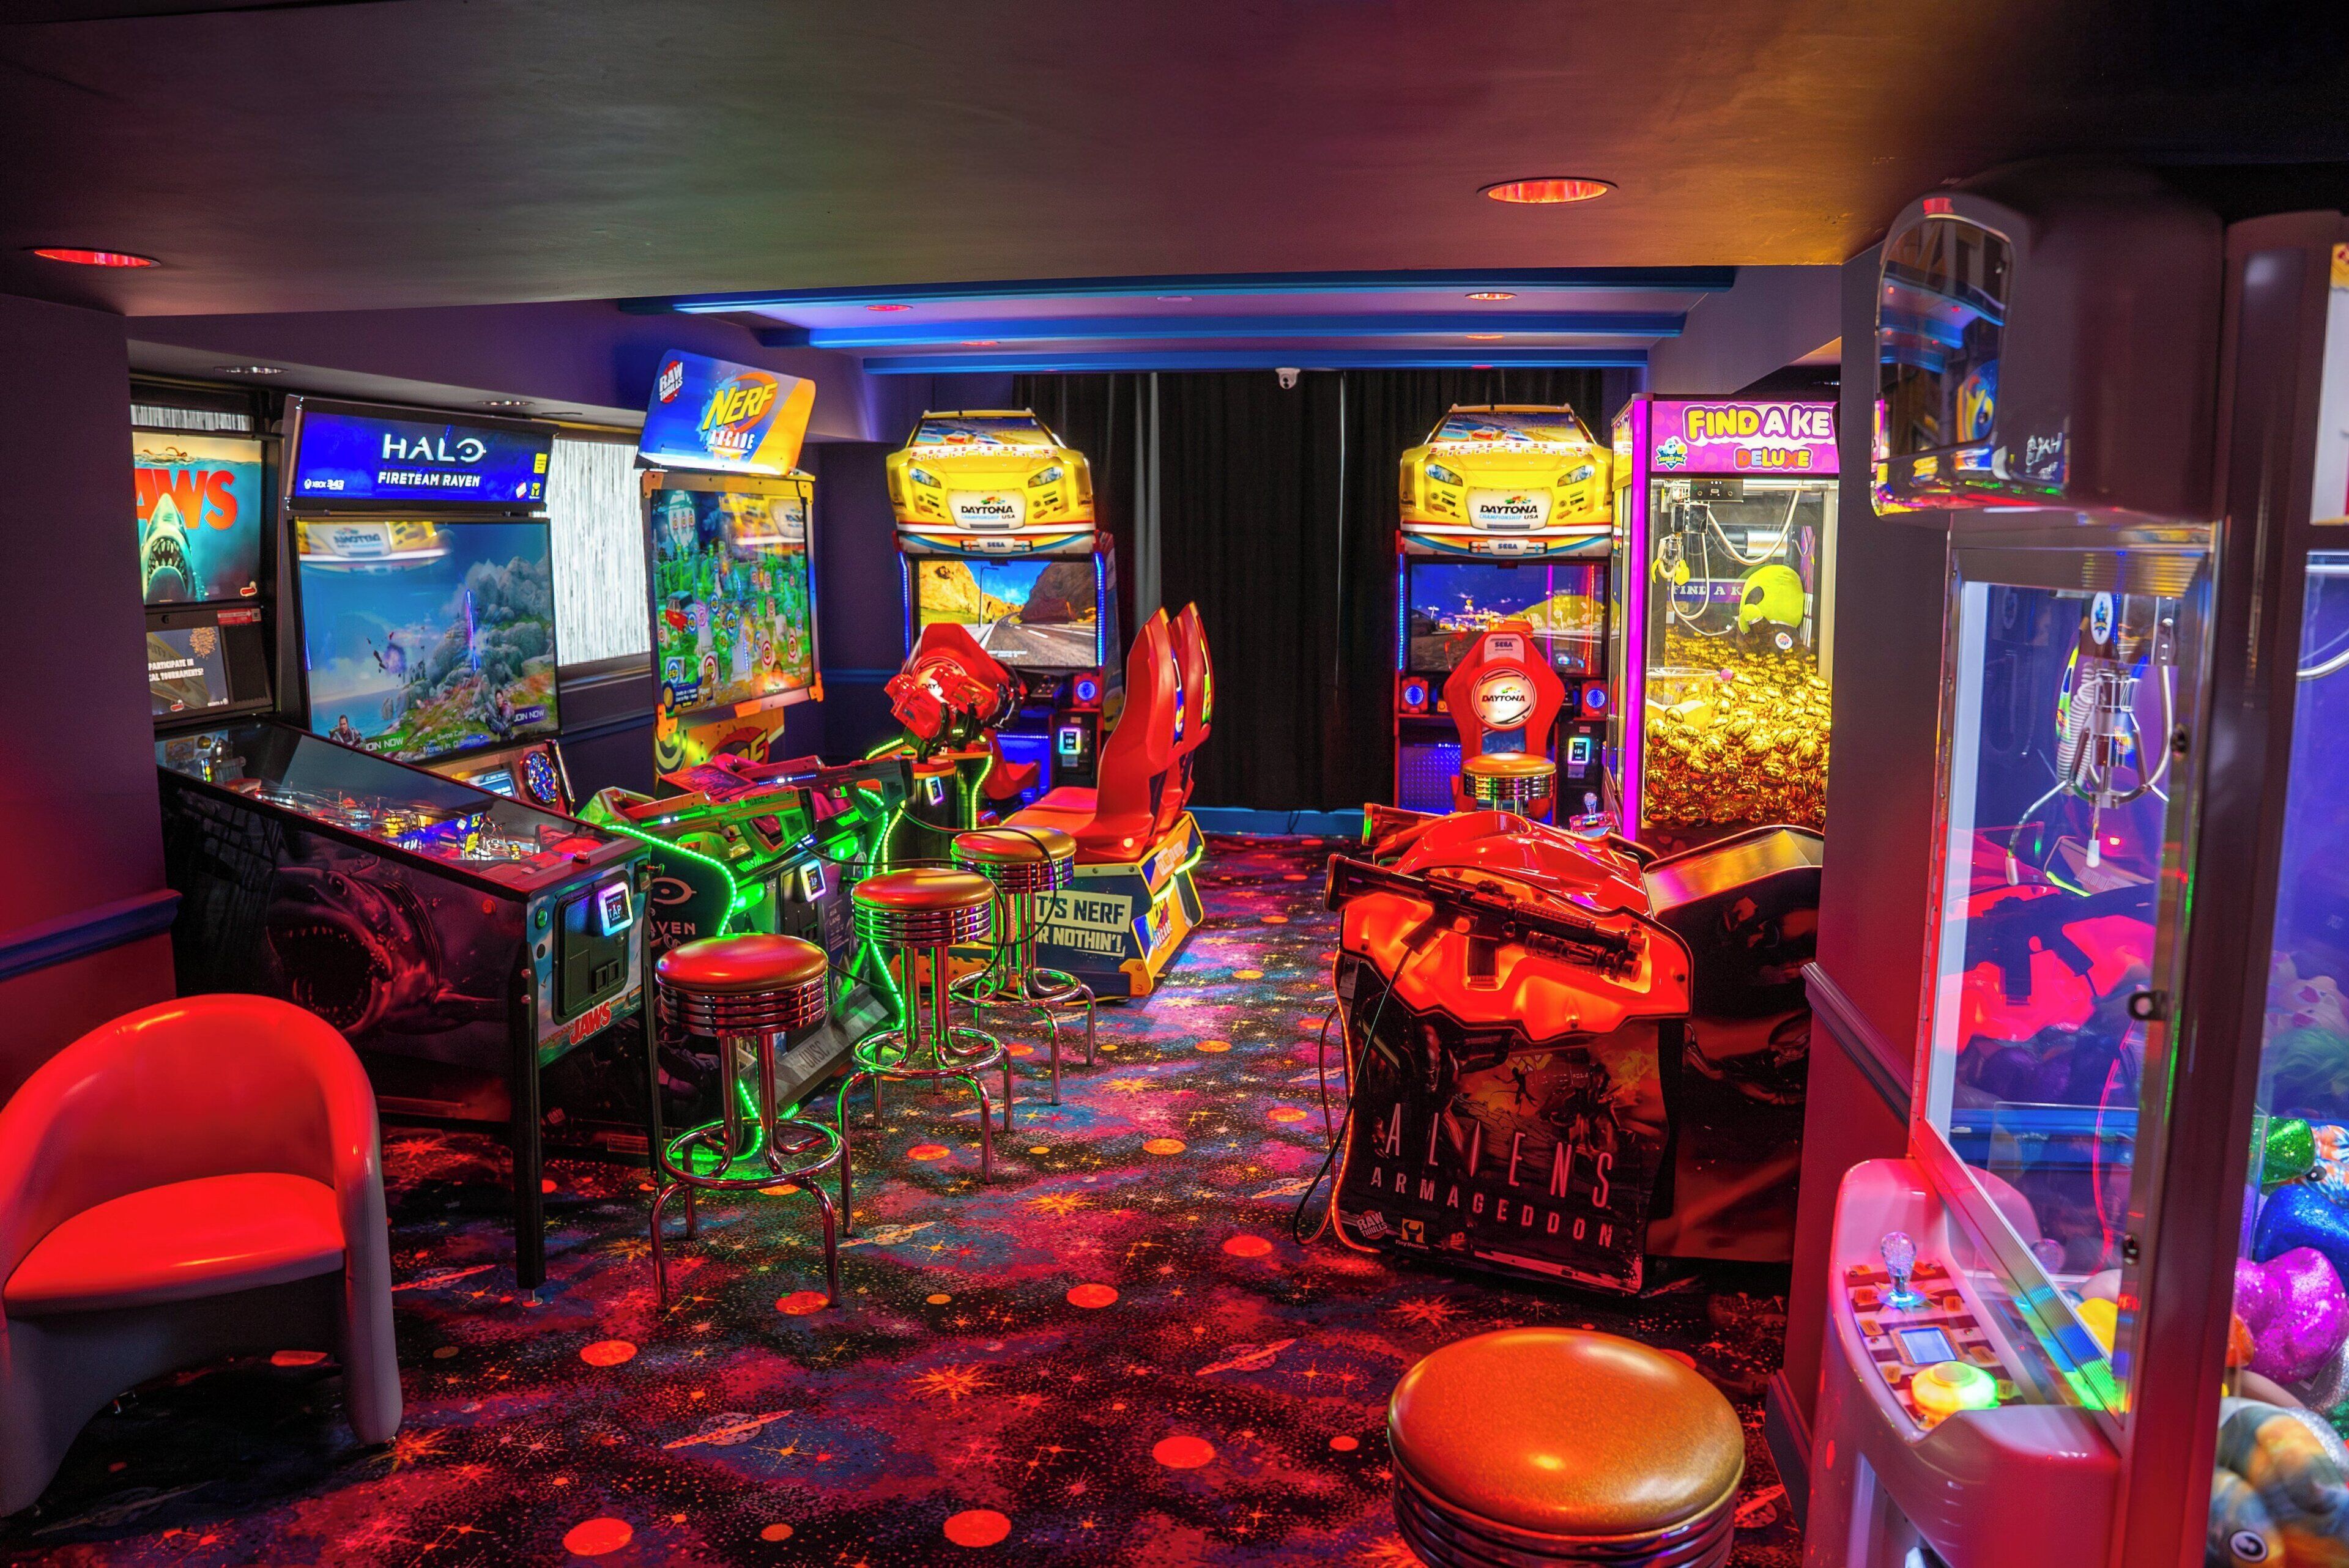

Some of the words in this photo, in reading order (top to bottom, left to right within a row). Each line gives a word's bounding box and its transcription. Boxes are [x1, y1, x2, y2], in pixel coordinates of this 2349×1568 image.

[659, 362, 683, 392] RAW
[659, 377, 683, 401] THRILLS
[702, 382, 778, 431] NERF
[1688, 409, 1759, 439] FIND
[1763, 410, 1786, 435] A
[1792, 409, 1831, 437] KE
[382, 434, 486, 462] HALO
[709, 429, 755, 449] ARCADE
[1737, 448, 1810, 468] DELUXE
[377, 472, 439, 486] FIRETEAM
[442, 474, 480, 487] RAVEN
[135, 468, 238, 531] AWS
[1480, 505, 1537, 514] DAYTONA
[1674, 585, 1706, 594] FIND
[1713, 586, 1726, 595] A
[148, 659, 187, 671] PARTICIPATE
[160, 668, 204, 680] TOURNAMENTS!
[529, 709, 545, 719] NOW
[384, 737, 403, 748] NOW
[423, 744, 443, 753] Money
[608, 904, 622, 919] TAP
[1036, 895, 1067, 919] T'S
[1074, 899, 1125, 925] NERF
[649, 921, 696, 935] AVEN
[1053, 927, 1122, 952] NOTHIN'!
[570, 1001, 611, 1046] JAWS
[798, 1040, 830, 1068] UNSC
[1385, 1103, 1613, 1208] ALIENS
[1370, 1167, 1613, 1248] ARMAGEDDON
[1357, 1211, 1384, 1231] RAW
[1361, 1222, 1387, 1237] THRILLS
